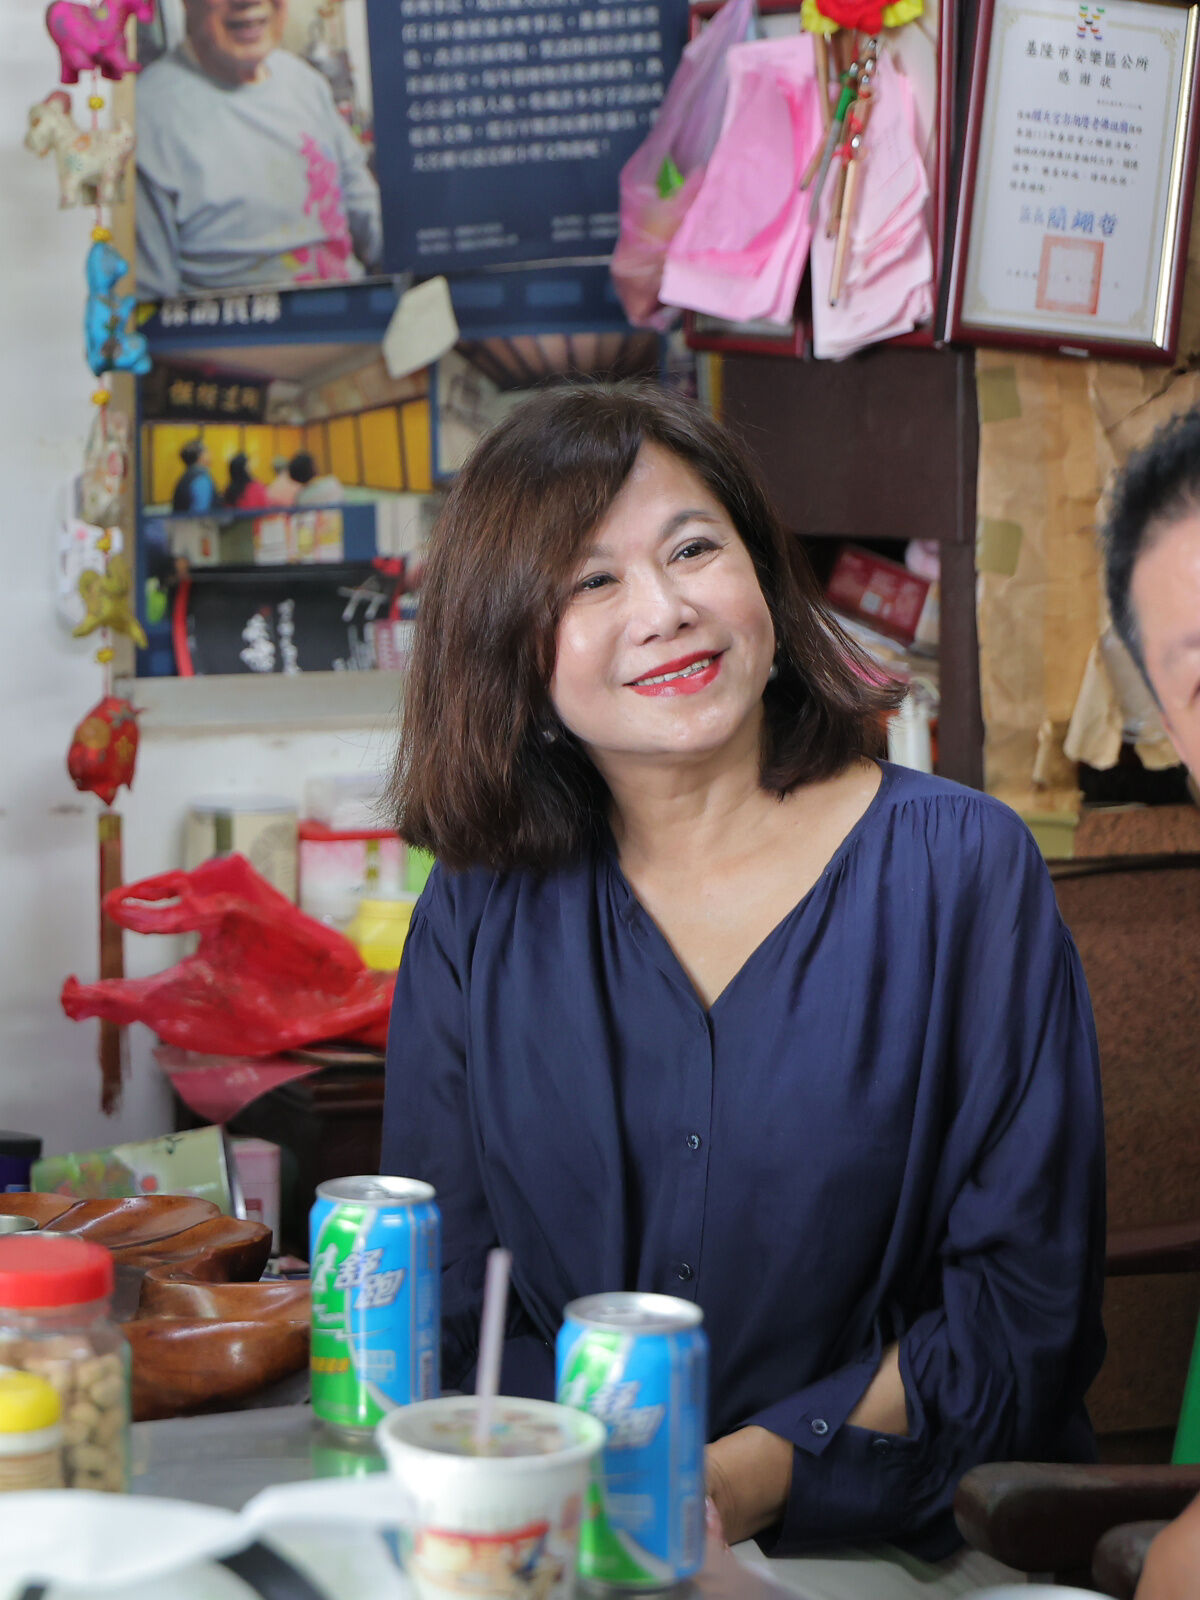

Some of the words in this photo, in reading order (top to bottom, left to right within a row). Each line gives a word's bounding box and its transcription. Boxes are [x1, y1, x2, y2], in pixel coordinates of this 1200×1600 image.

[1024, 40, 1151, 72] 基隆市安樂區公所
[1058, 69, 1113, 90] 感謝狀
